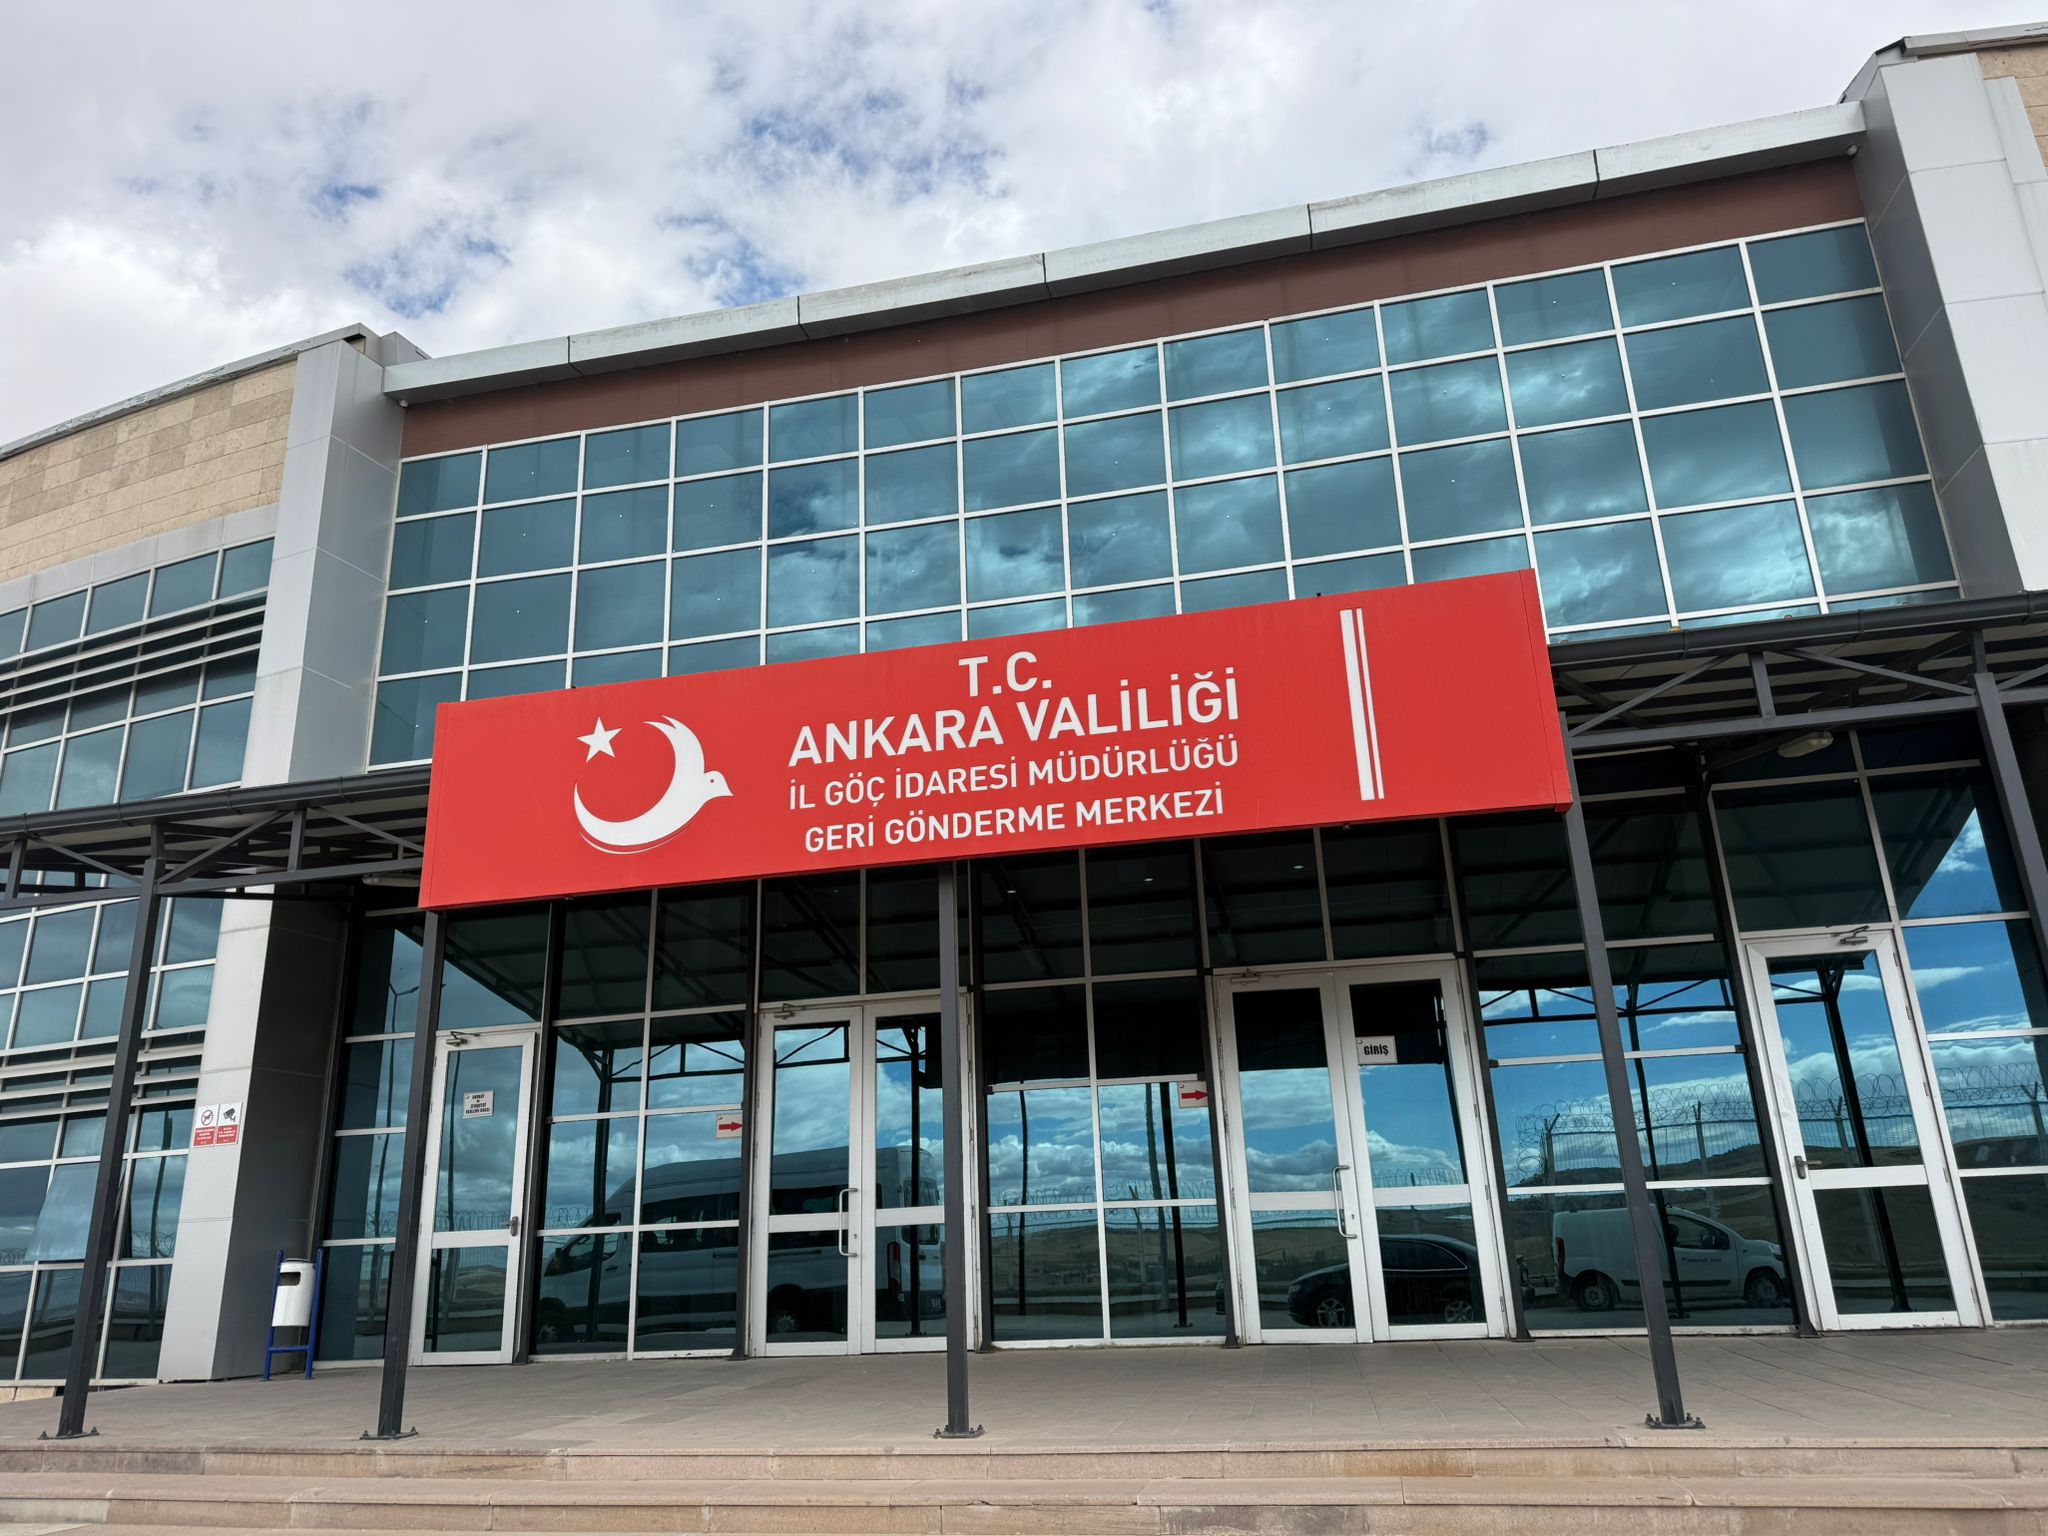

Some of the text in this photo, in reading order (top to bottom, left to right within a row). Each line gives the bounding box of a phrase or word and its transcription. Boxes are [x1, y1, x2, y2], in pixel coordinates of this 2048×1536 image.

[958, 652, 1052, 697] T.C.
[788, 666, 1239, 767] ANKARA VALİLİĞİ
[789, 733, 1238, 810] İL GÖÇ İDARESİ MÜDÜRLÜĞÜ
[805, 781, 1223, 853] GERİ GÖNDERME MERKEZİ
[1363, 1043, 1389, 1056] GİRİŞ
